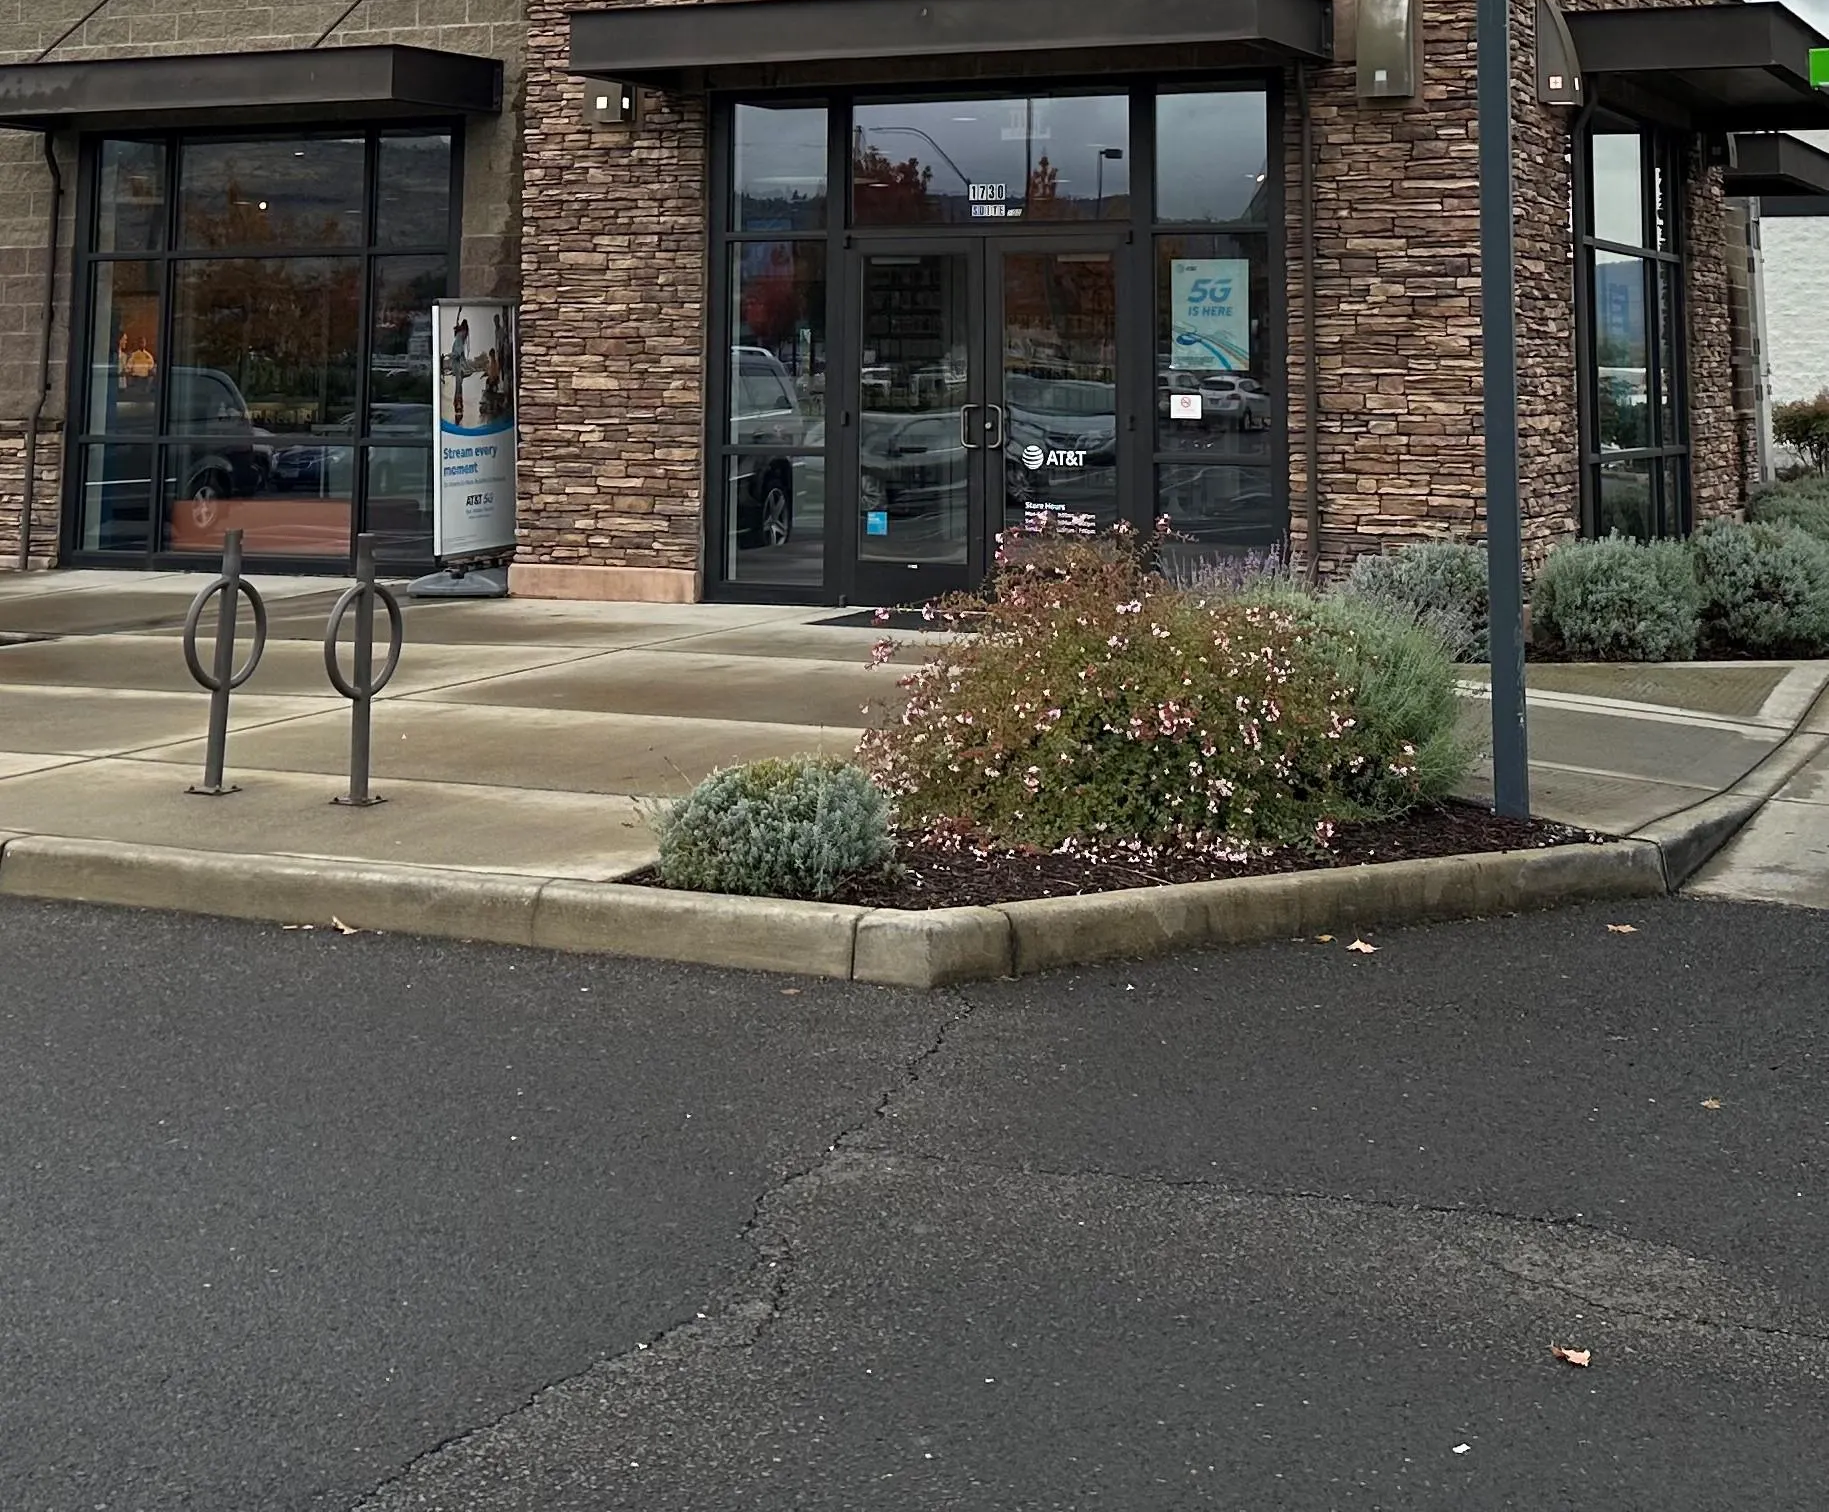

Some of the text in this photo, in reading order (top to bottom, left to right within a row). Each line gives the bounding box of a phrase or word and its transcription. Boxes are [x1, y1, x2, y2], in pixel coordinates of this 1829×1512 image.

[971, 184, 1004, 199] 1730
[972, 205, 1004, 216] SUITE
[1187, 278, 1233, 303] 5G
[1188, 306, 1232, 317] IS HERE
[443, 445, 498, 460] Stream every
[1046, 449, 1087, 467] AT&T
[443, 462, 479, 477] moment
[465, 494, 483, 507] AT&T
[1025, 501, 1066, 511] Store Hours
